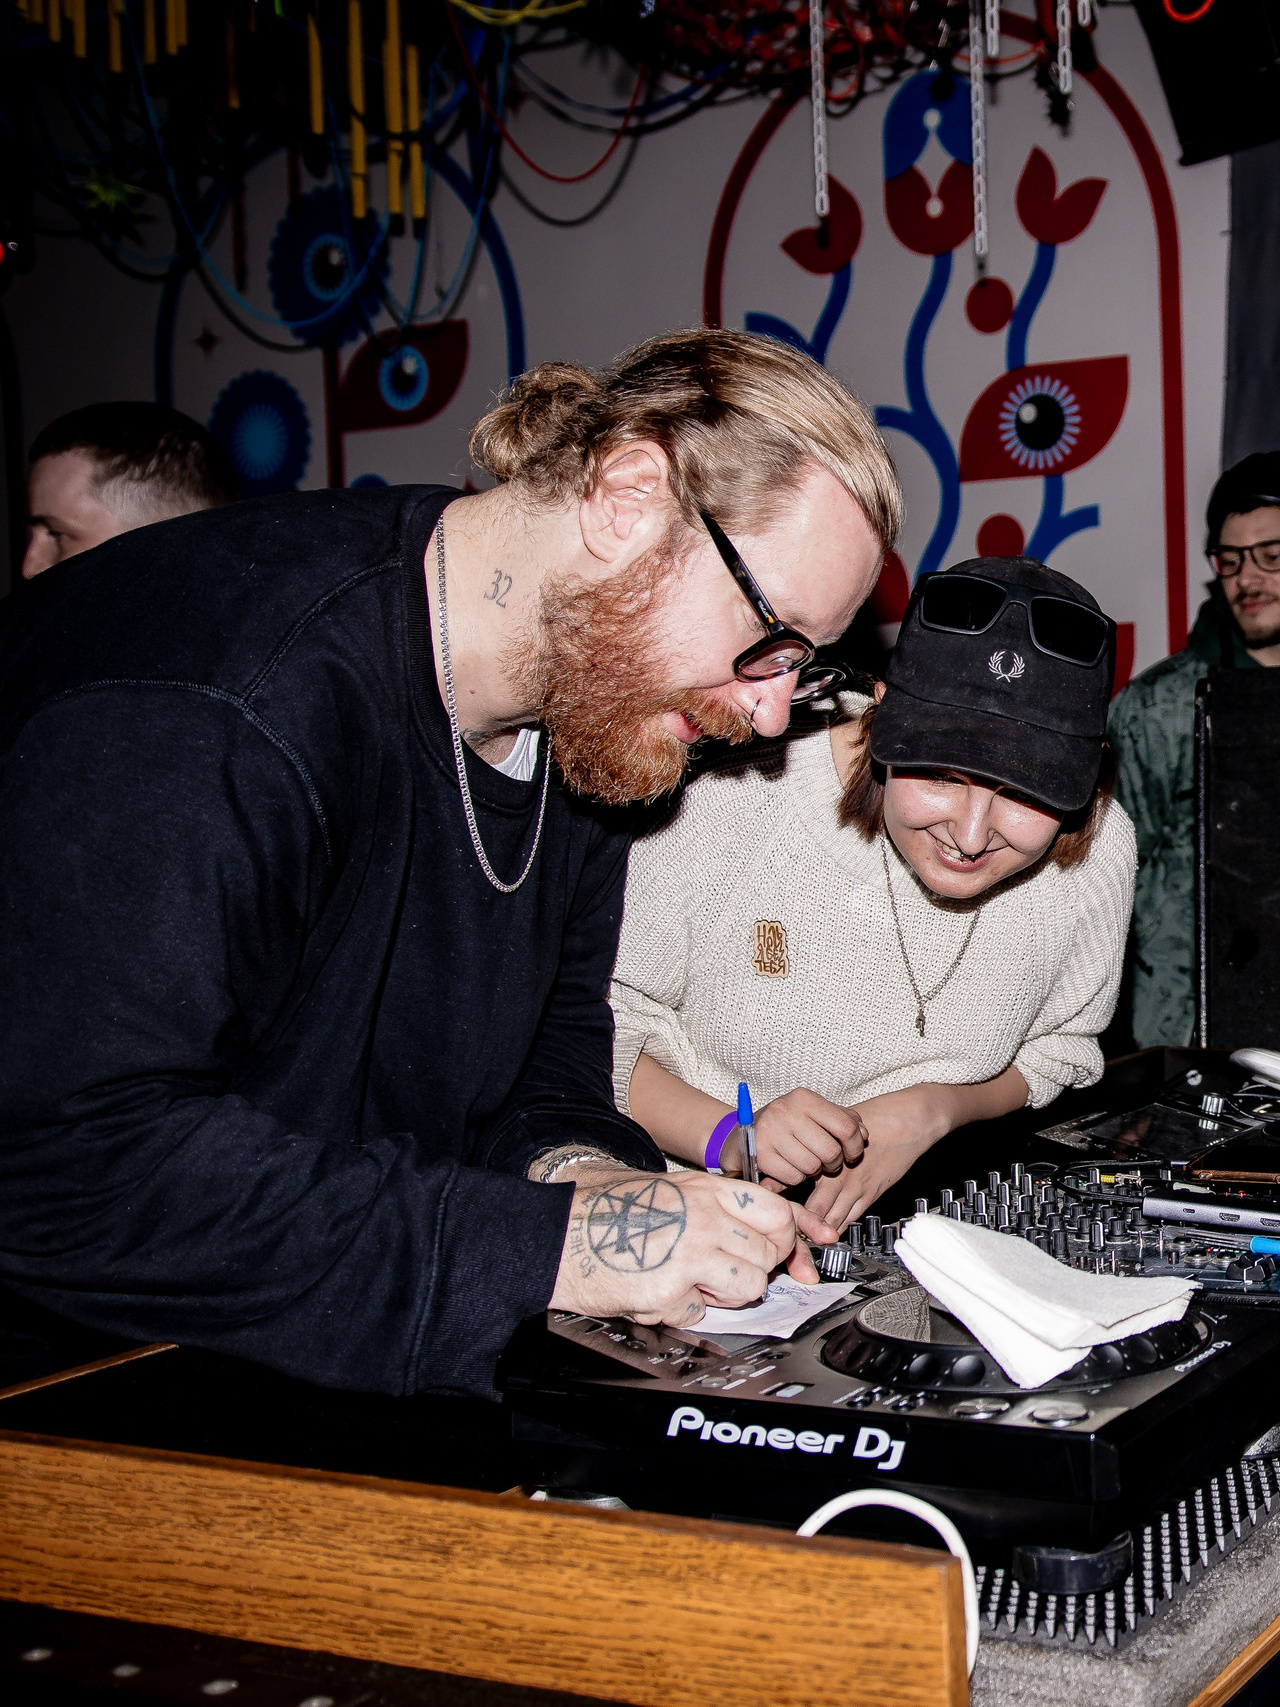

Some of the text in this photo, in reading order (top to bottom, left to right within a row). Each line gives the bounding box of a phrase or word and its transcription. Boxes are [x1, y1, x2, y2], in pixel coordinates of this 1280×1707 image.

[483, 568, 513, 609] 32
[754, 959, 786, 975] ТЕБЯ
[666, 1405, 845, 1455] Pioneer
